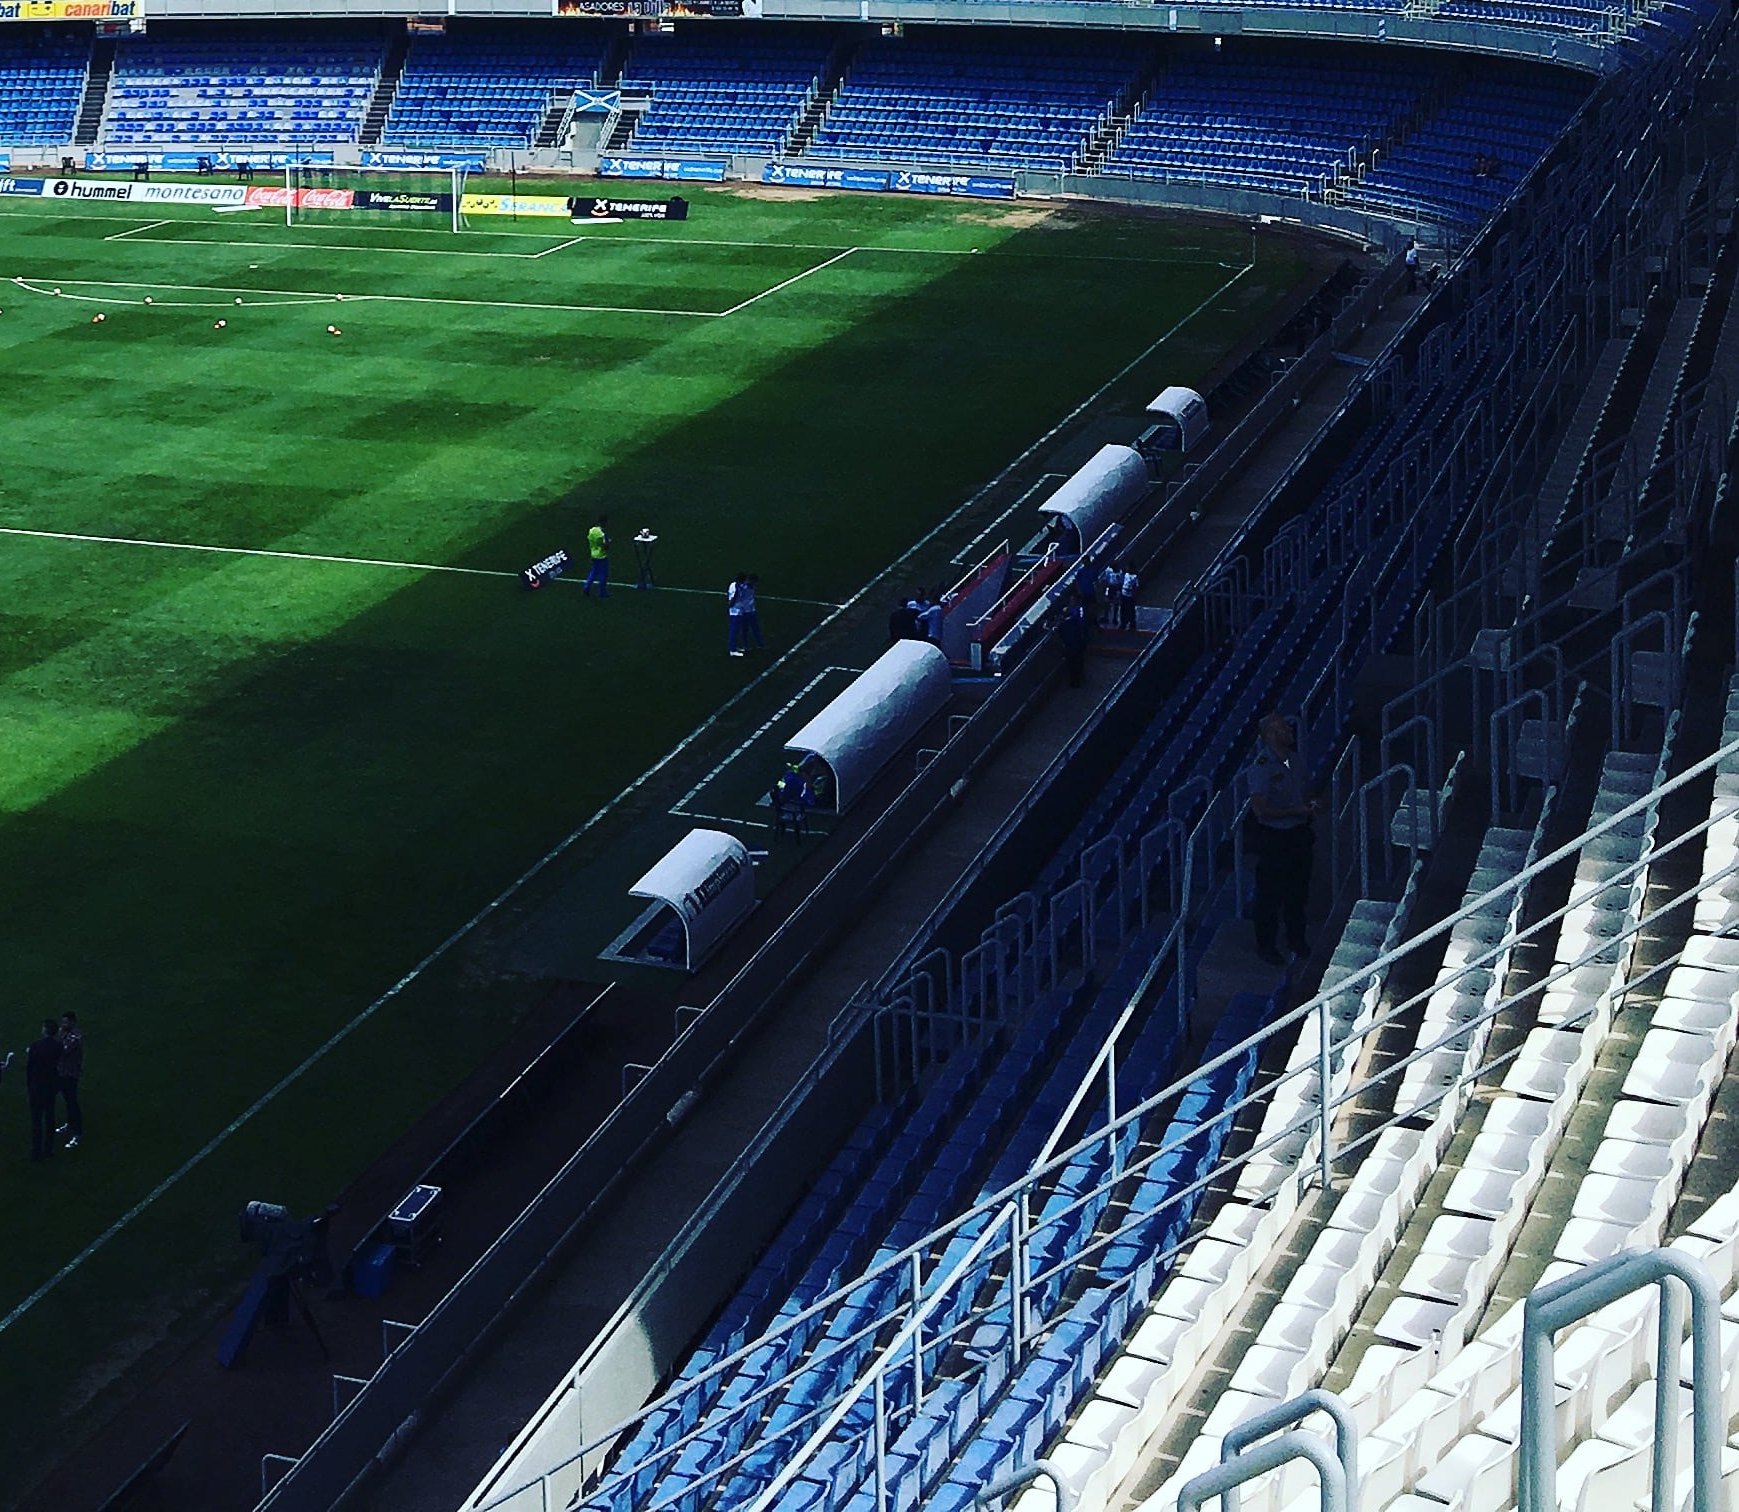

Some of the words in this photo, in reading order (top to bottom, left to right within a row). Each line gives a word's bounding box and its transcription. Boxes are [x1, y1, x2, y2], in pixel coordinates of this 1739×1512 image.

[65, 0, 136, 17] canaribat
[71, 181, 132, 200] hummel
[145, 185, 244, 200] montesano
[609, 202, 668, 213] TENERIFE
